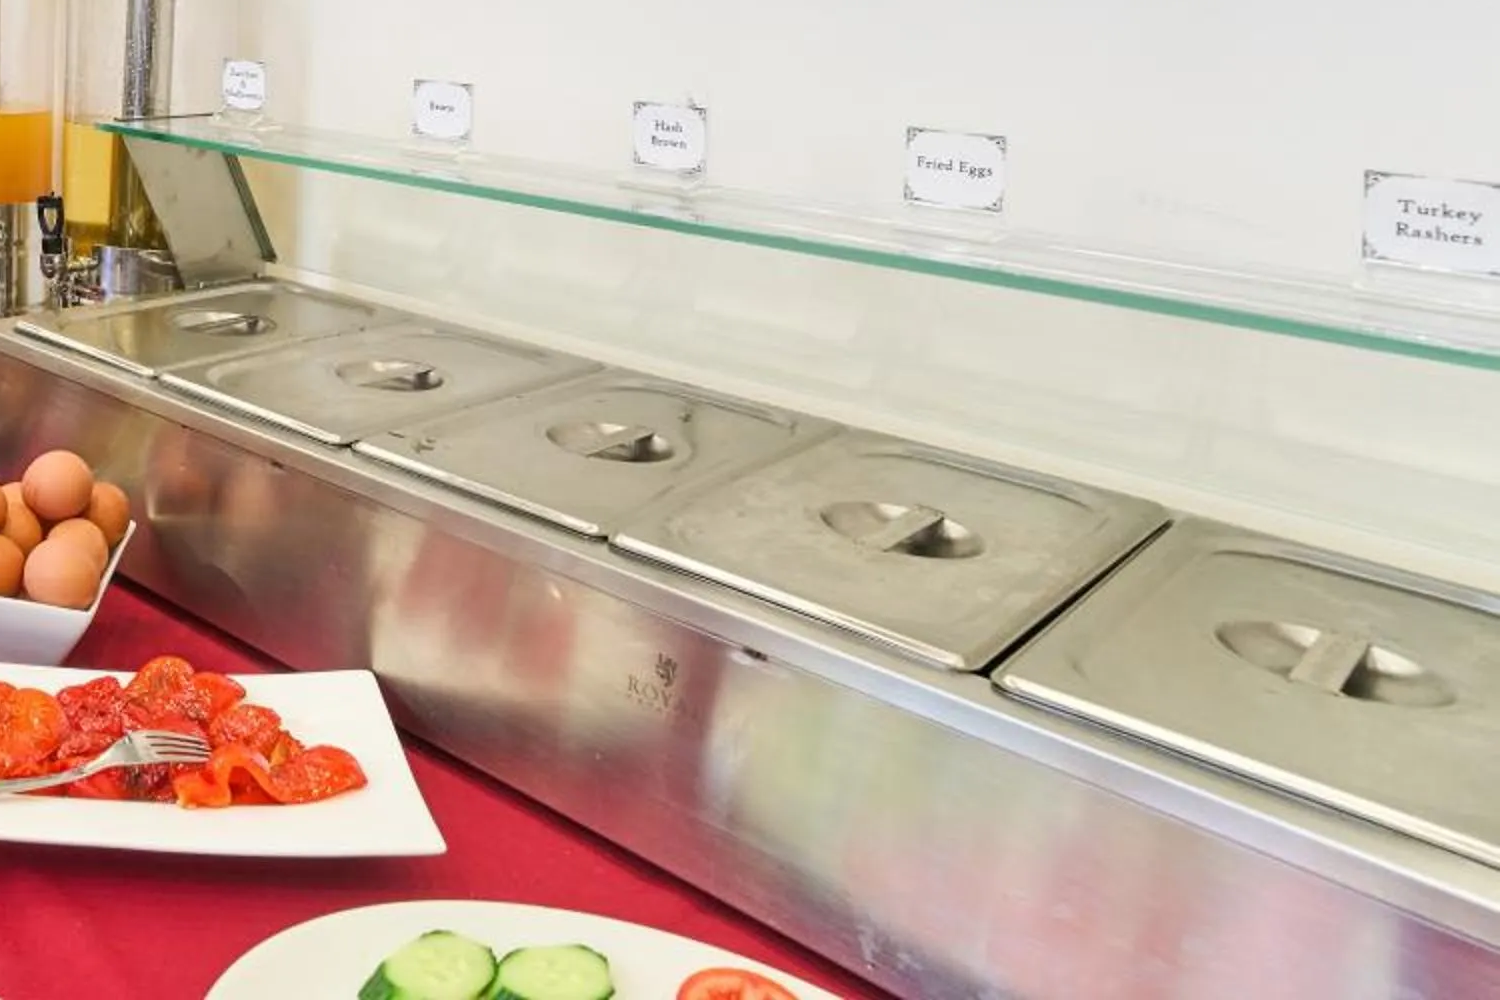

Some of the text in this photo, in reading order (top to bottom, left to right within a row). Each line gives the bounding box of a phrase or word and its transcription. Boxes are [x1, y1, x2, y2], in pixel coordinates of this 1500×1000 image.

[653, 119, 683, 132] Hash
[651, 135, 687, 149] Brown
[917, 155, 993, 178] Fried Eggs
[1396, 199, 1483, 226] Turkey
[1395, 221, 1484, 246] Rashers
